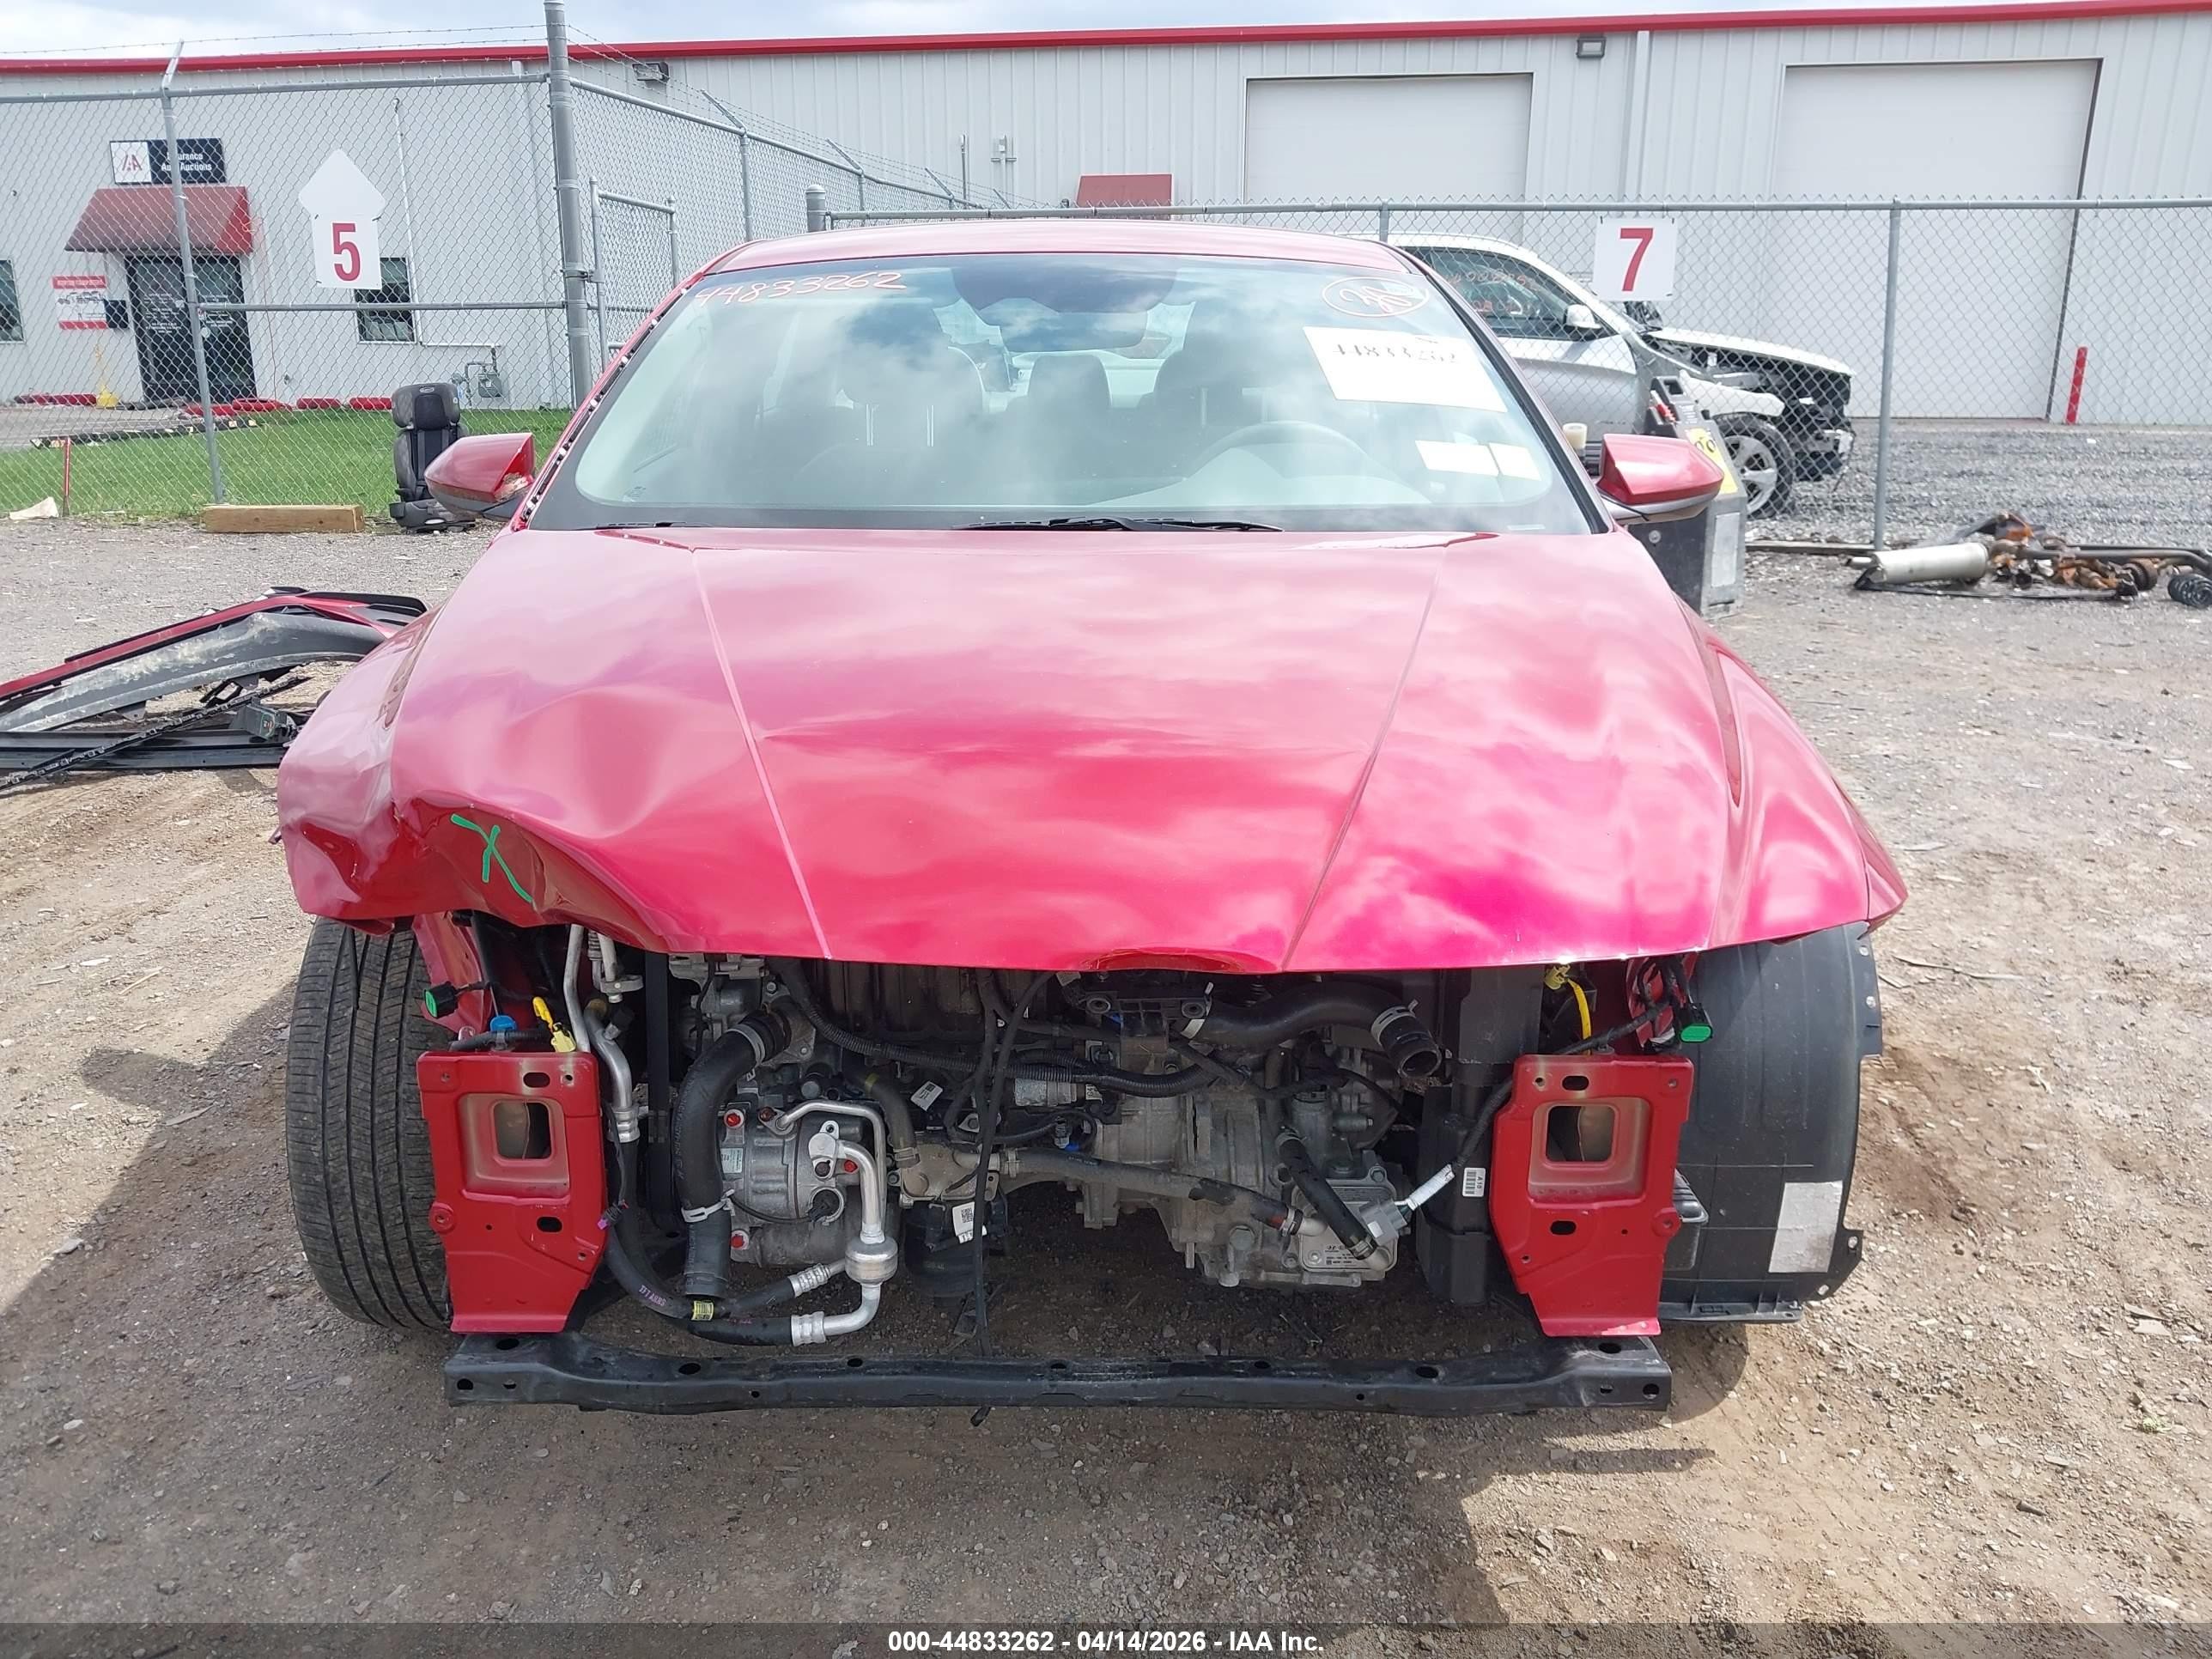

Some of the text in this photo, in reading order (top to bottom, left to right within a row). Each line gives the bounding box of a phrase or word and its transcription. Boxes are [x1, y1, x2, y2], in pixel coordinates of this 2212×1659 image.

[167, 152, 204, 161] Iurance
[332, 222, 361, 282] 5
[1620, 228, 1654, 292] 7
[695, 271, 907, 307] 44833262
